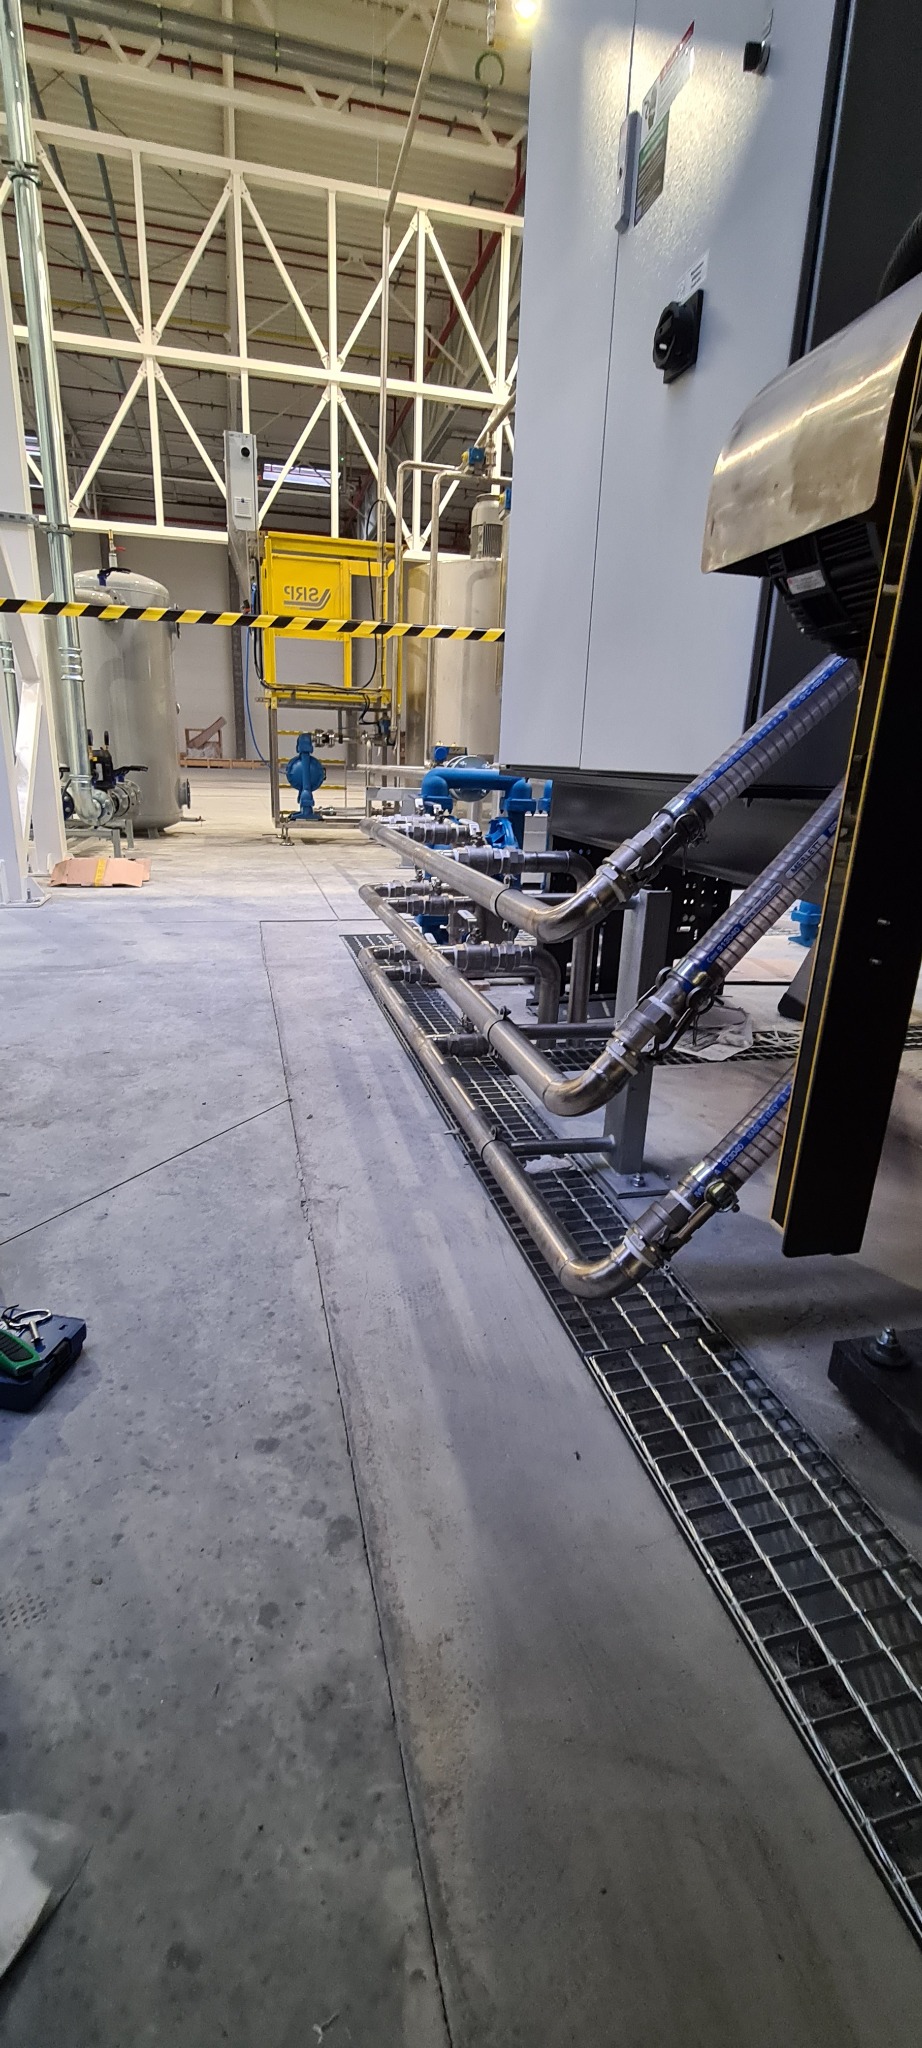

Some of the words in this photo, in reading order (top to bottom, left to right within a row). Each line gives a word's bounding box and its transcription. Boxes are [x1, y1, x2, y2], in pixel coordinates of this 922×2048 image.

[791, 842, 820, 872] MERLETT
[717, 927, 740, 951] 913040
[722, 1143, 744, 1166] 913040
